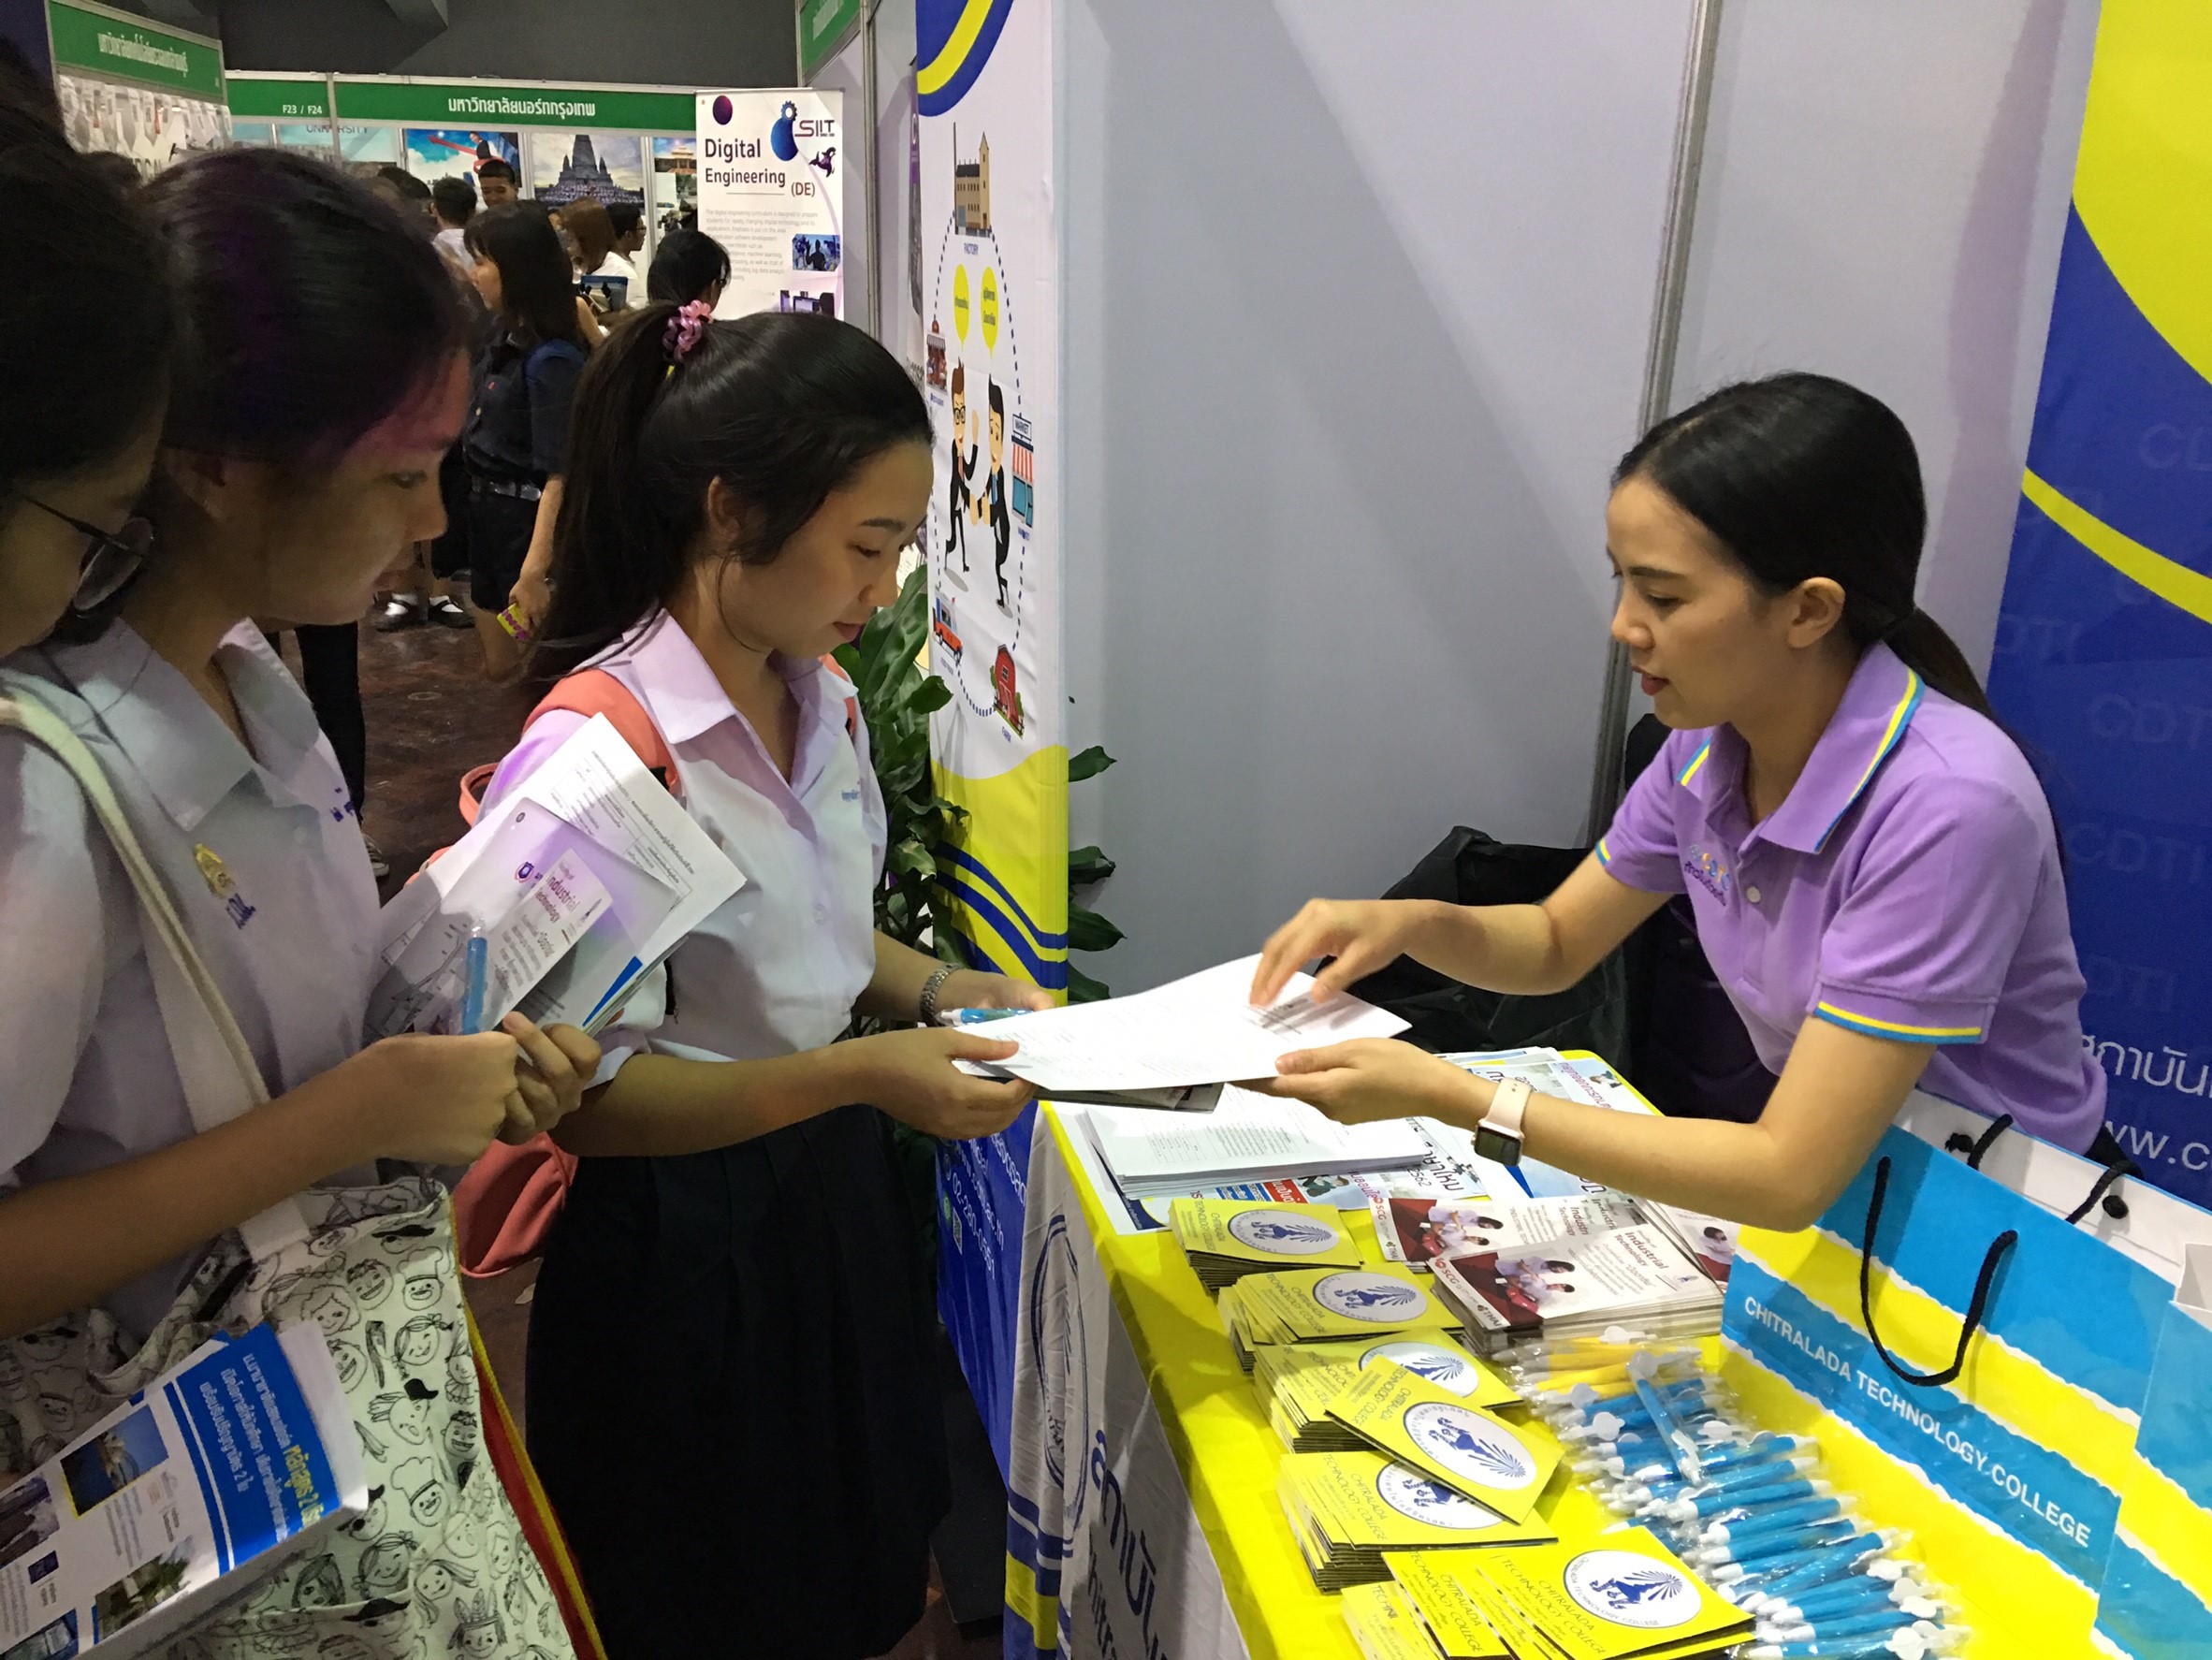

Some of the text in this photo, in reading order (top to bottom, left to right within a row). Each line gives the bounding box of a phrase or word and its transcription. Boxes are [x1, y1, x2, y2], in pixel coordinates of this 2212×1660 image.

[283, 105, 298, 114] F23
[308, 105, 323, 114] F24
[447, 96, 596, 120] มหาวิทยาลัยนอร์ทกรุงเทพ
[705, 138, 761, 164] Digital
[706, 167, 816, 197] Engineering (DE)
[1406, 1168, 1432, 1187] 2562
[1194, 1201, 1210, 1235] TECHNOLOGY
[1375, 1204, 1387, 1219] SCG
[1614, 1234, 1649, 1267] Technology
[1625, 1231, 1669, 1270] Industrial
[1265, 1274, 1301, 1310] TECHNOLOGY
[1300, 1310, 1328, 1334] COLLEGE
[1291, 1287, 1326, 1319] CHITRALADA
[1444, 1269, 1501, 1327] SCG THAI
[1354, 1364, 1409, 1426] TECHNOLOGY COLLEGE
[1379, 1388, 1412, 1420] CHITRALADA
[1744, 1296, 2091, 1550] CHITRALADA TECHNOLOGY COLLEGE
[298, 1493, 319, 1507] 2
[1322, 1454, 1361, 1507] TECHNOLOGY
[1358, 1507, 1388, 1541] COLLEGE
[1350, 1473, 1387, 1521] CHITRALADA
[1409, 1551, 1485, 1653] TECHNOLOGY COLLEGE
[1440, 1574, 1482, 1627] CHITRALADA
[1501, 1559, 1562, 1618] TECHNOLOGY
[1564, 1620, 1609, 1655] COLLEGE
[1538, 1580, 1595, 1630] CHITRALADA
